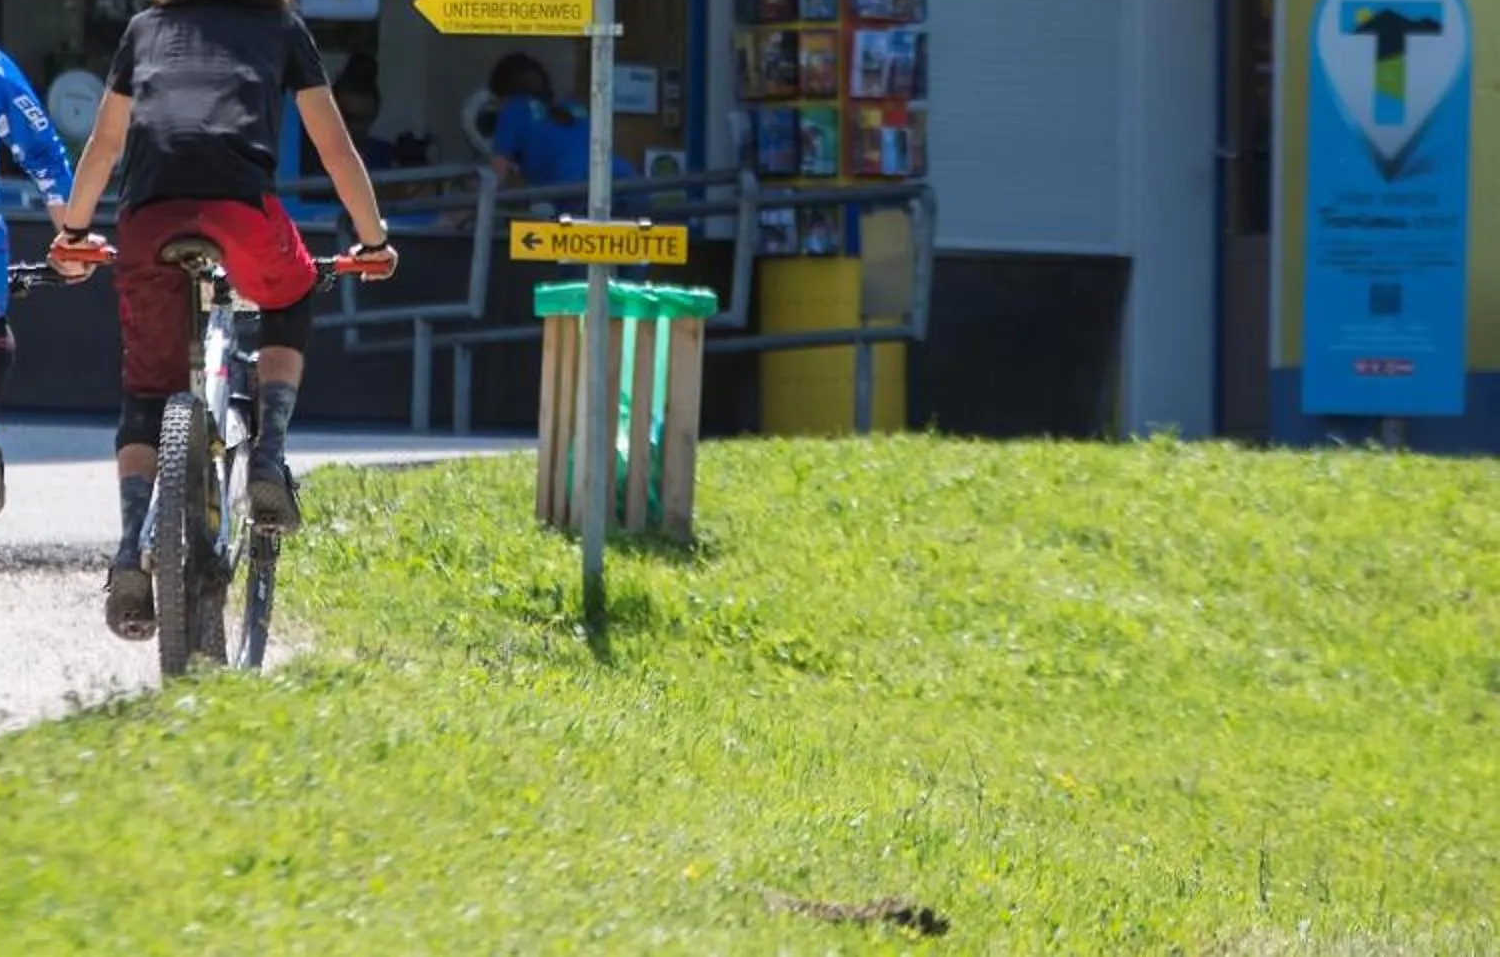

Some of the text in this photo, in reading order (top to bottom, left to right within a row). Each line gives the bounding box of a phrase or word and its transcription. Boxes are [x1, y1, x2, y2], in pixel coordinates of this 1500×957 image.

[442, 2, 583, 20] UNTERBERGENWEG
[13, 93, 50, 133] EGO
[550, 233, 678, 257] MOSTHÜTTE
